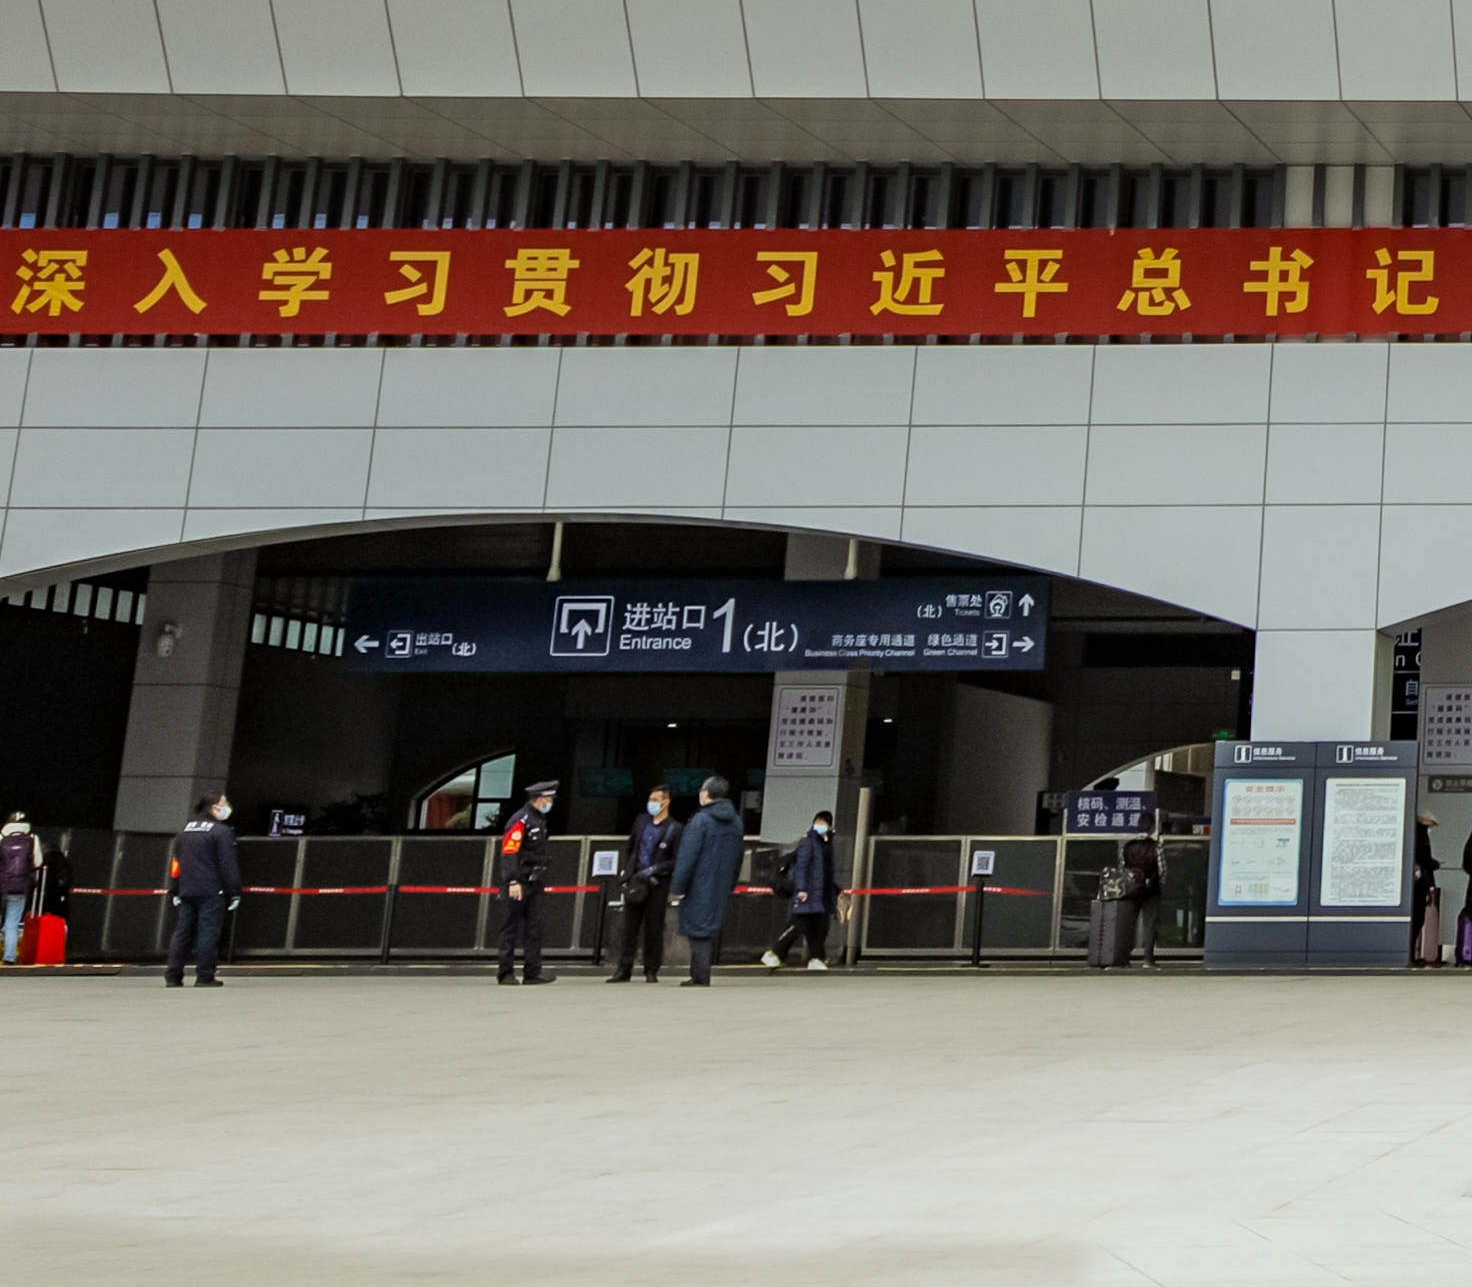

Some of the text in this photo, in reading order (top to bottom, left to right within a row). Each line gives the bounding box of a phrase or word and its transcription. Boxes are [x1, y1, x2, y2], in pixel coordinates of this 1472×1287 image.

[946, 594, 982, 607] 售票处
[622, 603, 705, 631] 进站口
[954, 608, 980, 616] Tickets
[415, 632, 453, 645] 出站口
[619, 634, 692, 650] Entrance
[831, 634, 978, 647] 商务座专用通道 绿色通道
[804, 648, 978, 658] Business Class Priority Channel Green Channel
[1253, 747, 1282, 756] 信息服务
[1355, 747, 1384, 755] 信息服务
[1077, 797, 1147, 810] 核码、测温、
